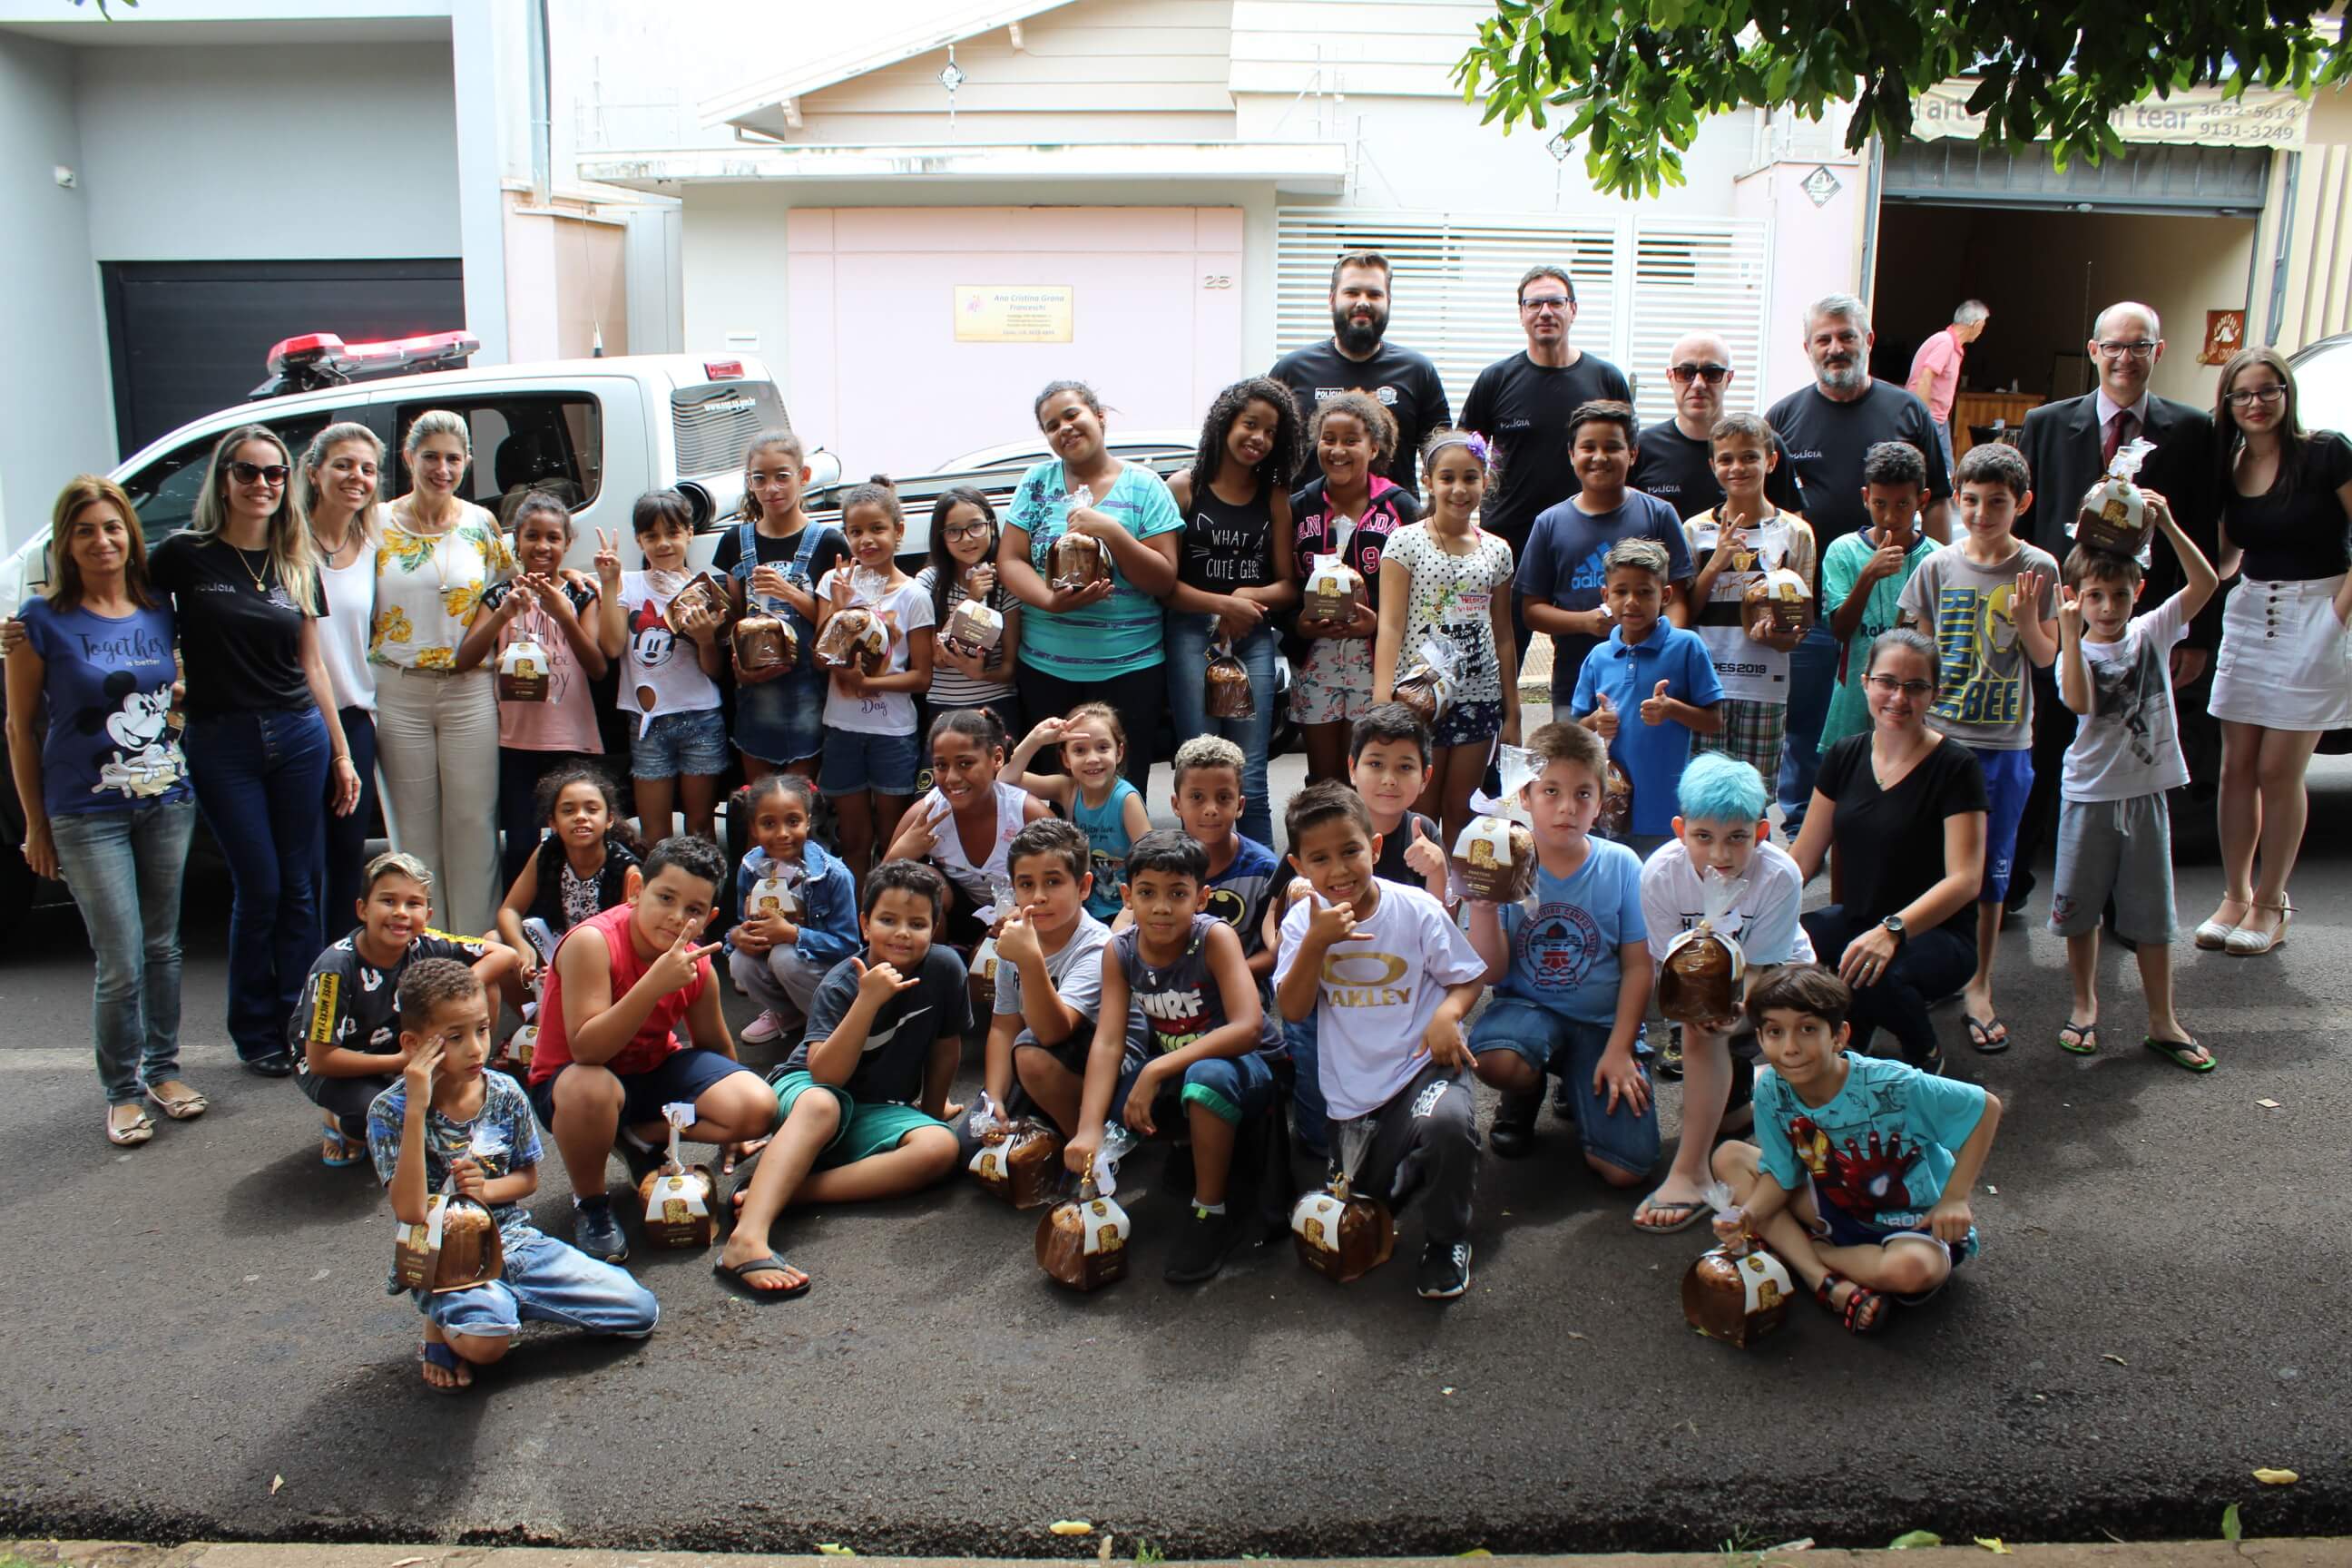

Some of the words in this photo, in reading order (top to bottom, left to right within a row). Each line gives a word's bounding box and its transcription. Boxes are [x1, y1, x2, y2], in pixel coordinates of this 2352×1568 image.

[2136, 104, 2191, 130] tear
[2199, 122, 2294, 140] 9131-3249
[1203, 275, 1232, 289] 25
[1211, 529, 1250, 547] WHAT
[1206, 558, 1234, 579] CUTE
[75, 629, 168, 663] Together
[135, 658, 161, 667] better
[861, 698, 887, 717] Dog
[1960, 681, 2020, 722] BEE
